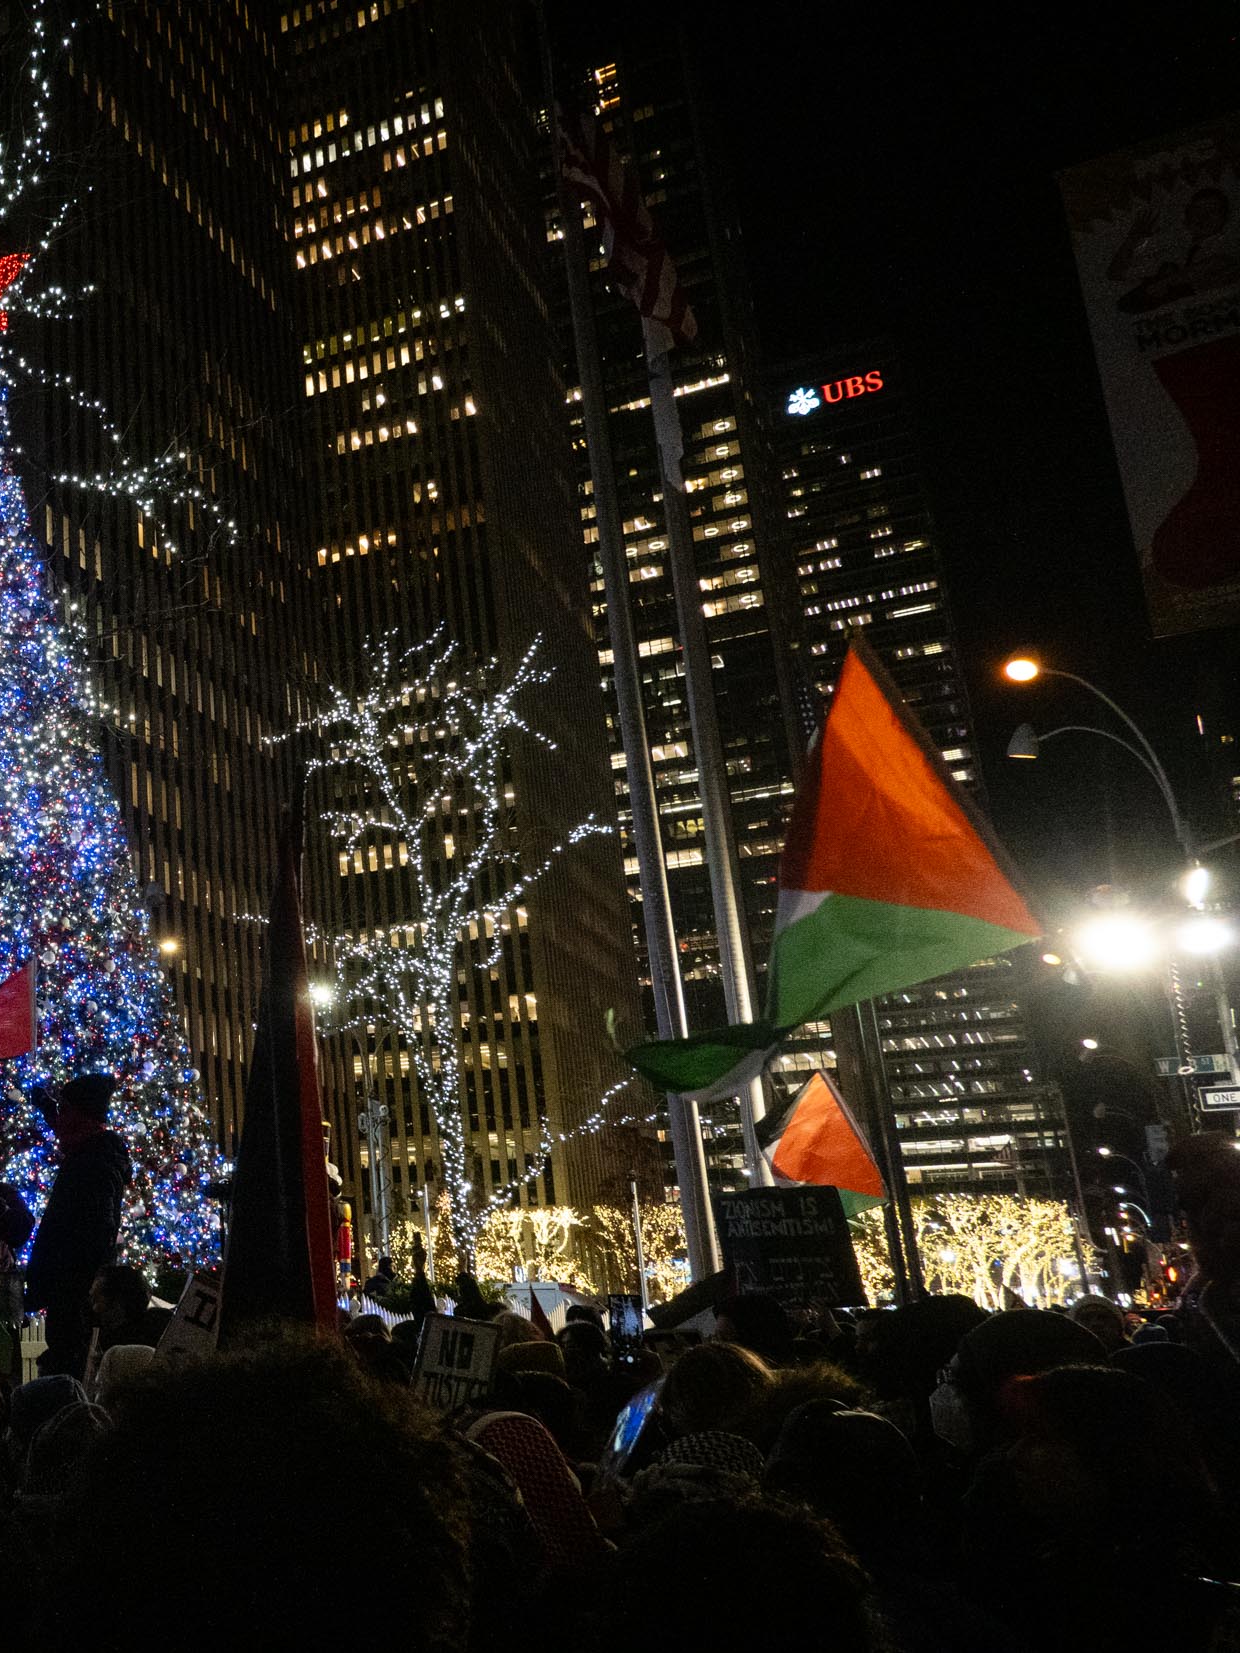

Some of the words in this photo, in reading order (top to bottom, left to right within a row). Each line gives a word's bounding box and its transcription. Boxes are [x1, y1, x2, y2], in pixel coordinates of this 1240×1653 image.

[821, 370, 885, 404] UBS
[1213, 1093, 1237, 1103] ONE
[720, 1198, 786, 1220] ZIONISM
[799, 1196, 819, 1216] IS
[727, 1216, 835, 1238] ANTISEMITISM!
[437, 1329, 475, 1370] NO
